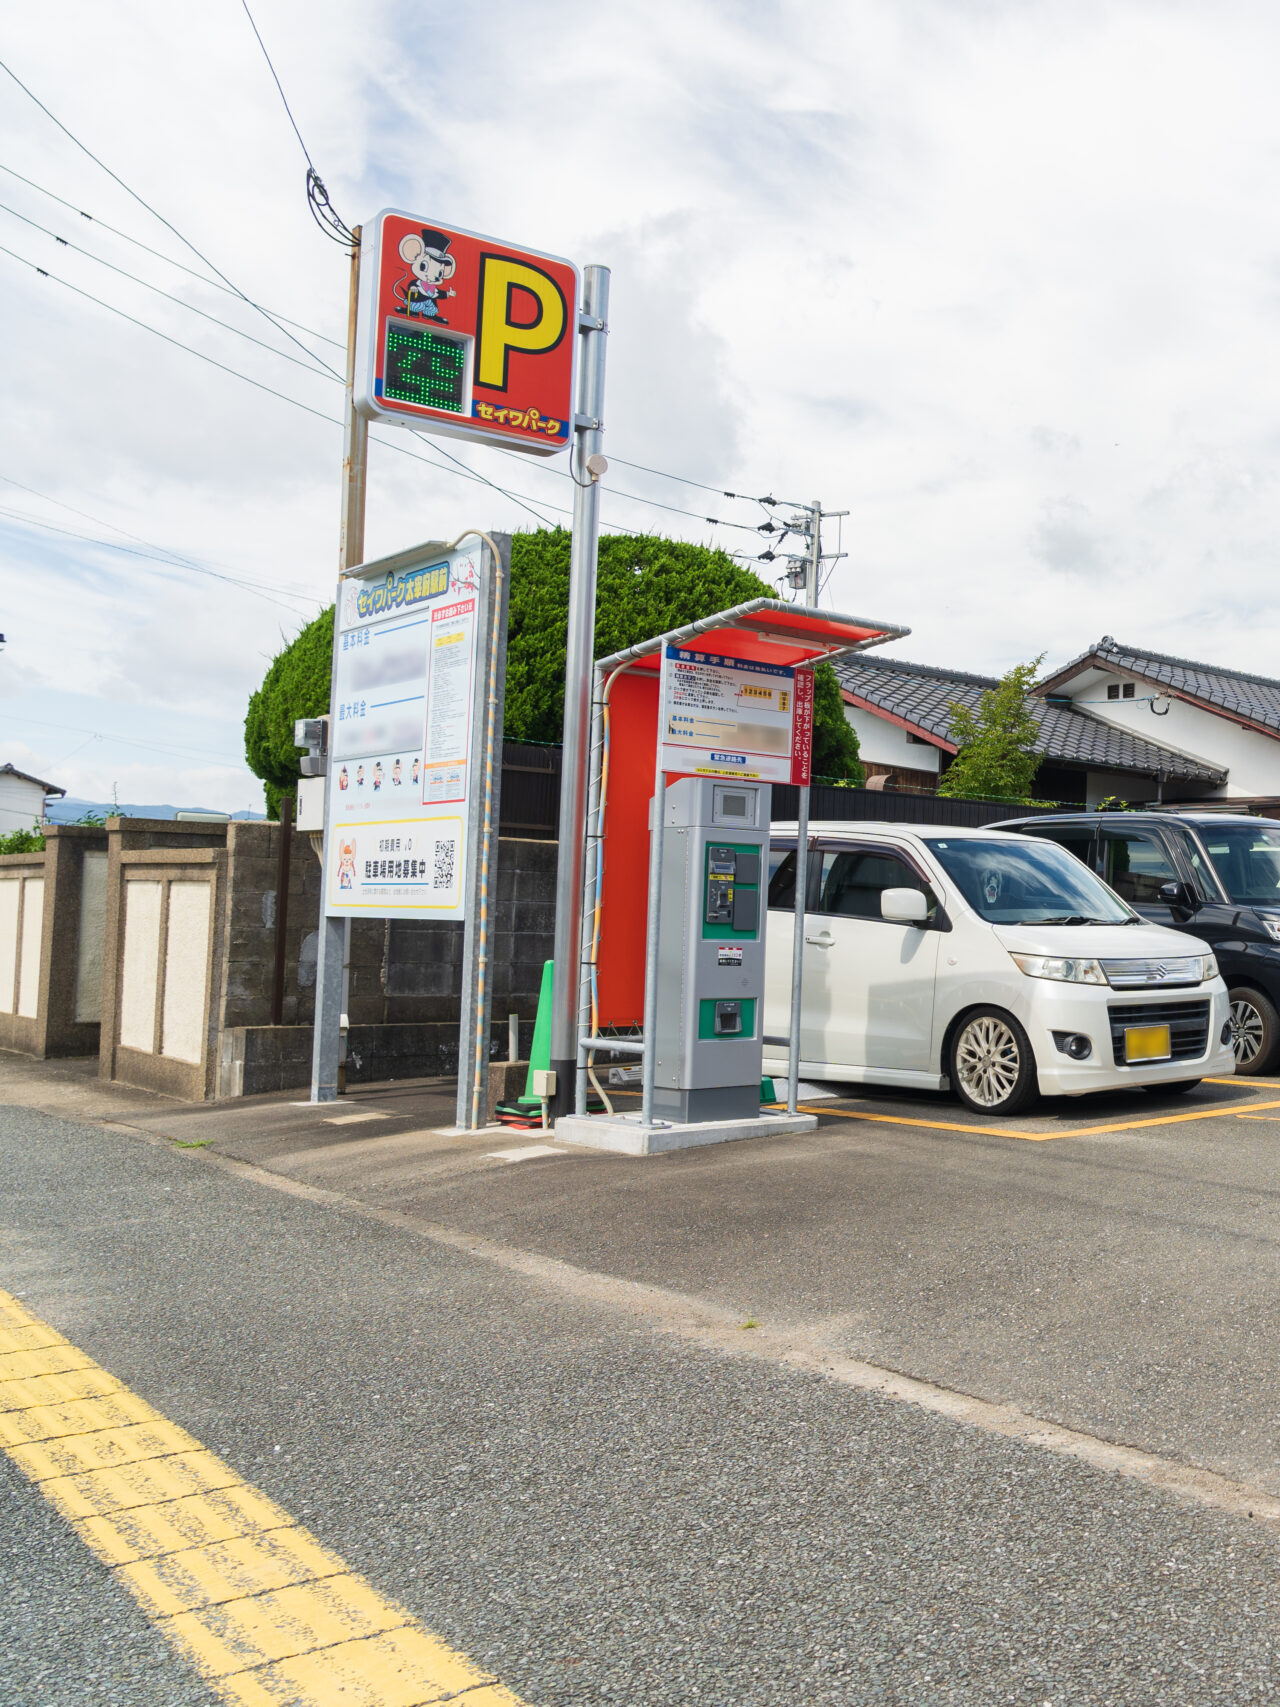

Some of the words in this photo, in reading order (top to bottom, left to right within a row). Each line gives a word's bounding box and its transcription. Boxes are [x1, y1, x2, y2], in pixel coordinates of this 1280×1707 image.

[474, 252, 568, 393] P
[385, 332, 465, 413] 空
[477, 402, 561, 436] セイワパーク
[679, 650, 735, 668] 精算手順
[339, 700, 367, 720] 最大料金
[365, 859, 426, 879] 駐車場用地募集中
